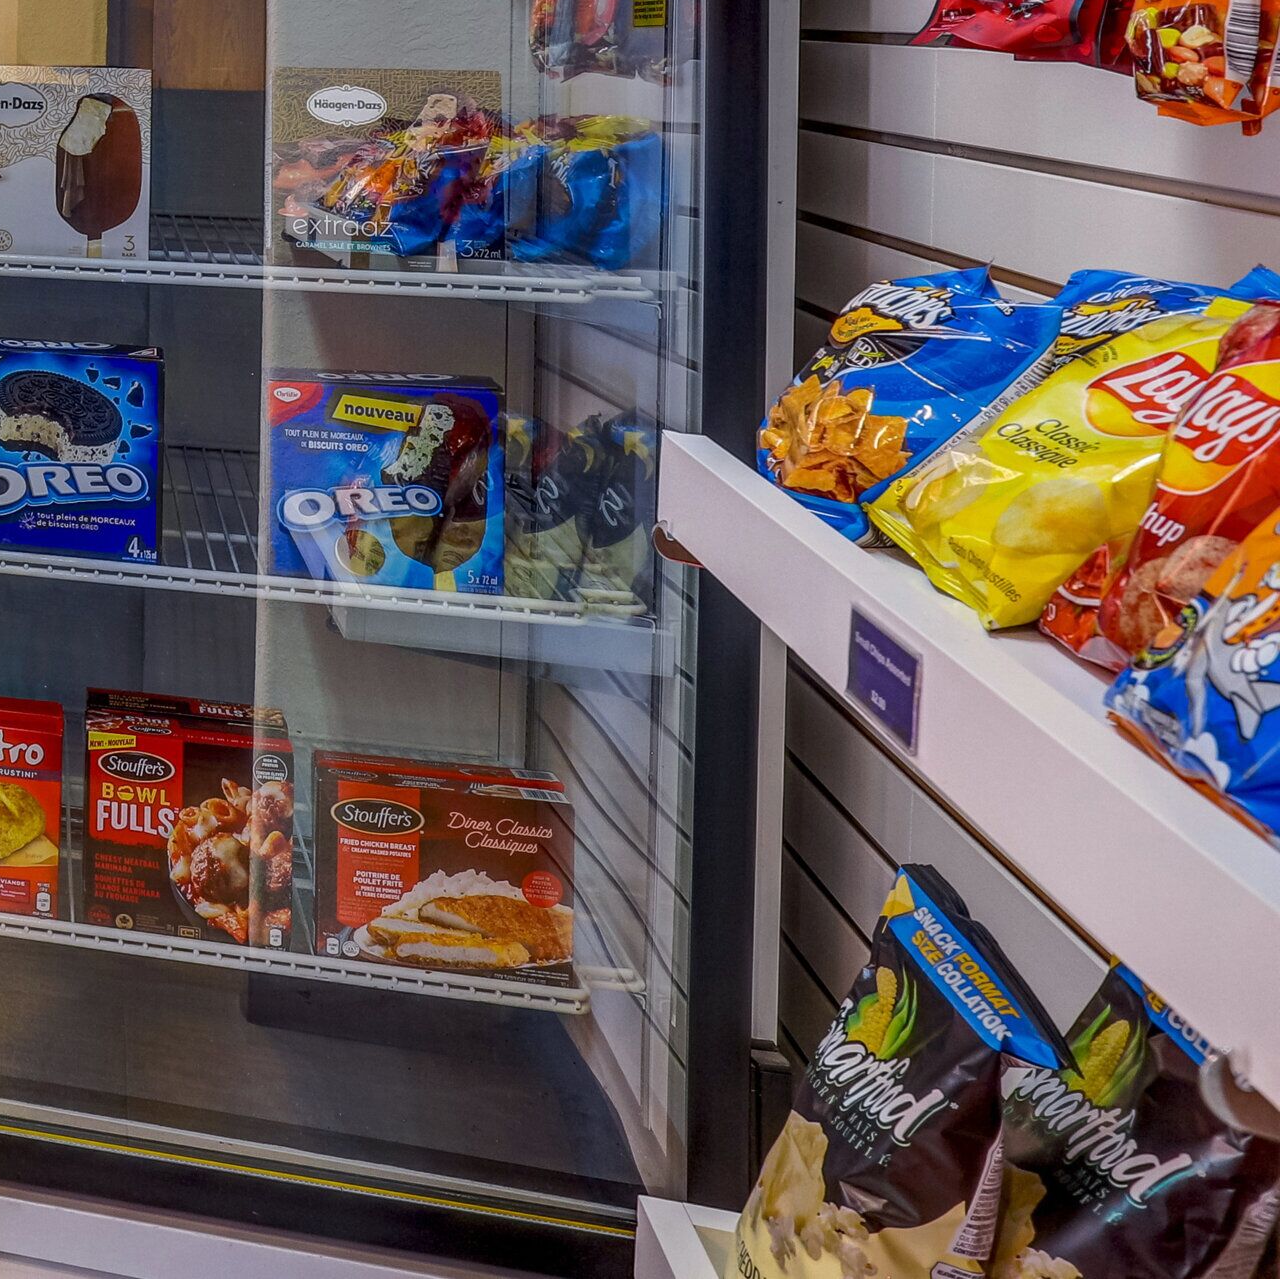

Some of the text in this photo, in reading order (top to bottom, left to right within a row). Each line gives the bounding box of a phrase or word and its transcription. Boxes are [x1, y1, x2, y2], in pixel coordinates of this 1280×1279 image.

[313, 98, 382, 111] Häagen-Dazs
[123, 235, 135, 251] 3
[343, 402, 416, 425] nouveau
[284, 428, 364, 442] TOUT PLEIN MORCEAUX
[997, 422, 1083, 470] Classique
[1034, 417, 1103, 455] Classic
[308, 440, 369, 453] BISCUITS OREO
[282, 485, 439, 525] OREO
[37, 512, 54, 520] tout
[56, 514, 76, 522] plein
[91, 516, 136, 526] MORCEAUX
[48, 521, 80, 530] biscuits
[128, 537, 139, 558] 4
[107, 755, 164, 777] Stouffer's
[97, 800, 174, 839] FULLS
[342, 804, 412, 828] Stouffer's
[448, 811, 553, 839] Diner Classics
[360, 839, 387, 849] CHICKEN
[389, 843, 416, 851] BREAST
[465, 833, 538, 855] Classiques
[353, 876, 403, 888] POULET FRITE
[356, 870, 387, 880] POITRINE
[913, 905, 1020, 1022] SNACK FORMAT
[910, 929, 1015, 1043] SIZE COLLATION
